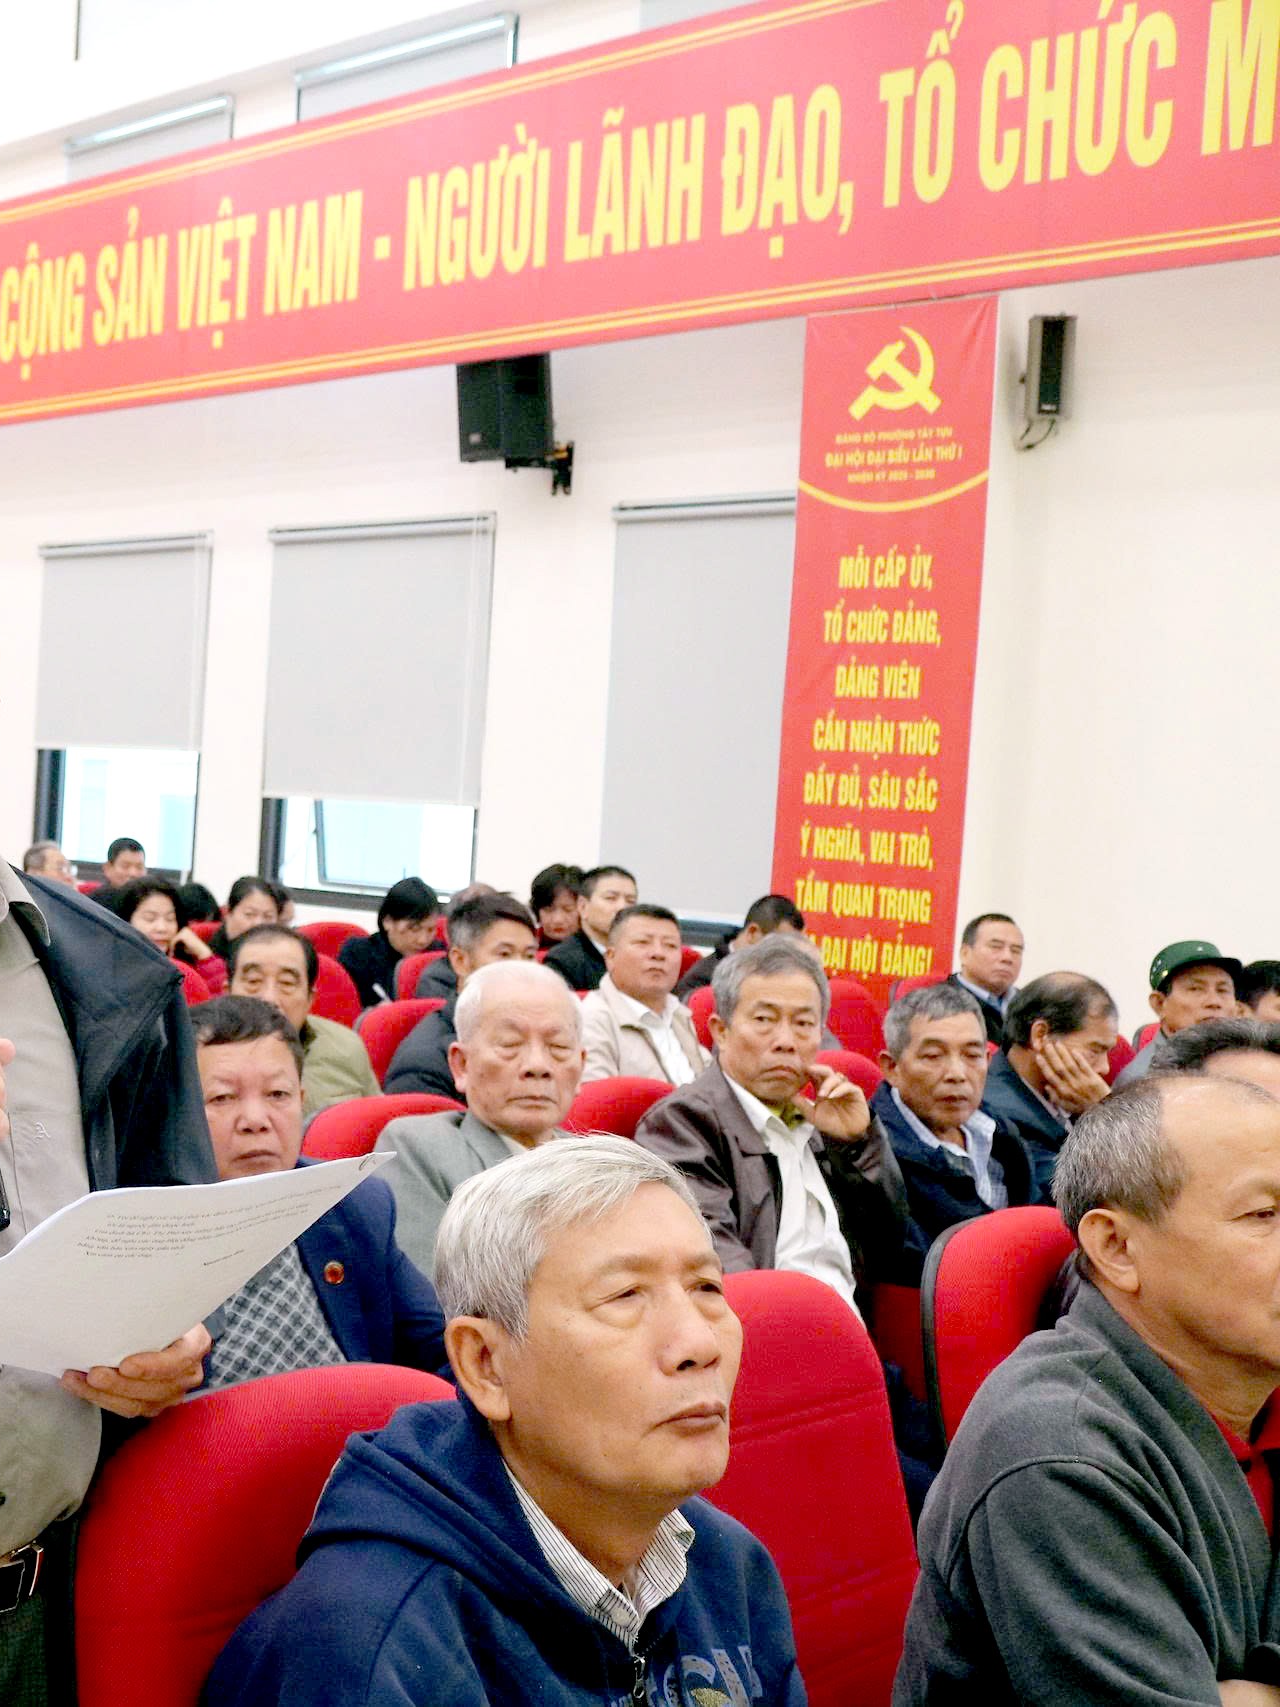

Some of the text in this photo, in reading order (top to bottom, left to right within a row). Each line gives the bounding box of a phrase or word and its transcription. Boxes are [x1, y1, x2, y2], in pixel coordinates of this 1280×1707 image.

[92, 207, 168, 344] SẢN
[177, 197, 257, 348] VIỆT
[264, 191, 362, 315] NAM
[403, 123, 550, 290] NGƯỜI
[564, 106, 705, 263] LÃNH
[722, 84, 854, 258] ĐẠO,
[880, 1, 966, 208] TỔ
[979, 0, 1177, 192] CHỨC
[873, 544, 907, 589] CẤP
[910, 544, 933, 592] ỦY,
[823, 598, 942, 648] TỔ CHỨC ĐẢNG,
[834, 655, 921, 699] ĐẢNG VIÊN
[849, 714, 895, 760] NHẬN
[899, 715, 940, 756] THỨC
[837, 763, 863, 811] ĐỦ,
[868, 769, 901, 810] SÂU
[904, 766, 939, 813] SẮC
[800, 819, 933, 872] Ý NGHĨA, VAI TRÒ,
[832, 882, 875, 919] QUAN
[878, 885, 932, 928] TRỌNG
[823, 934, 848, 976] ĐẠI
[850, 934, 878, 979] HỘI
[881, 932, 933, 978] ĐẢNG!
